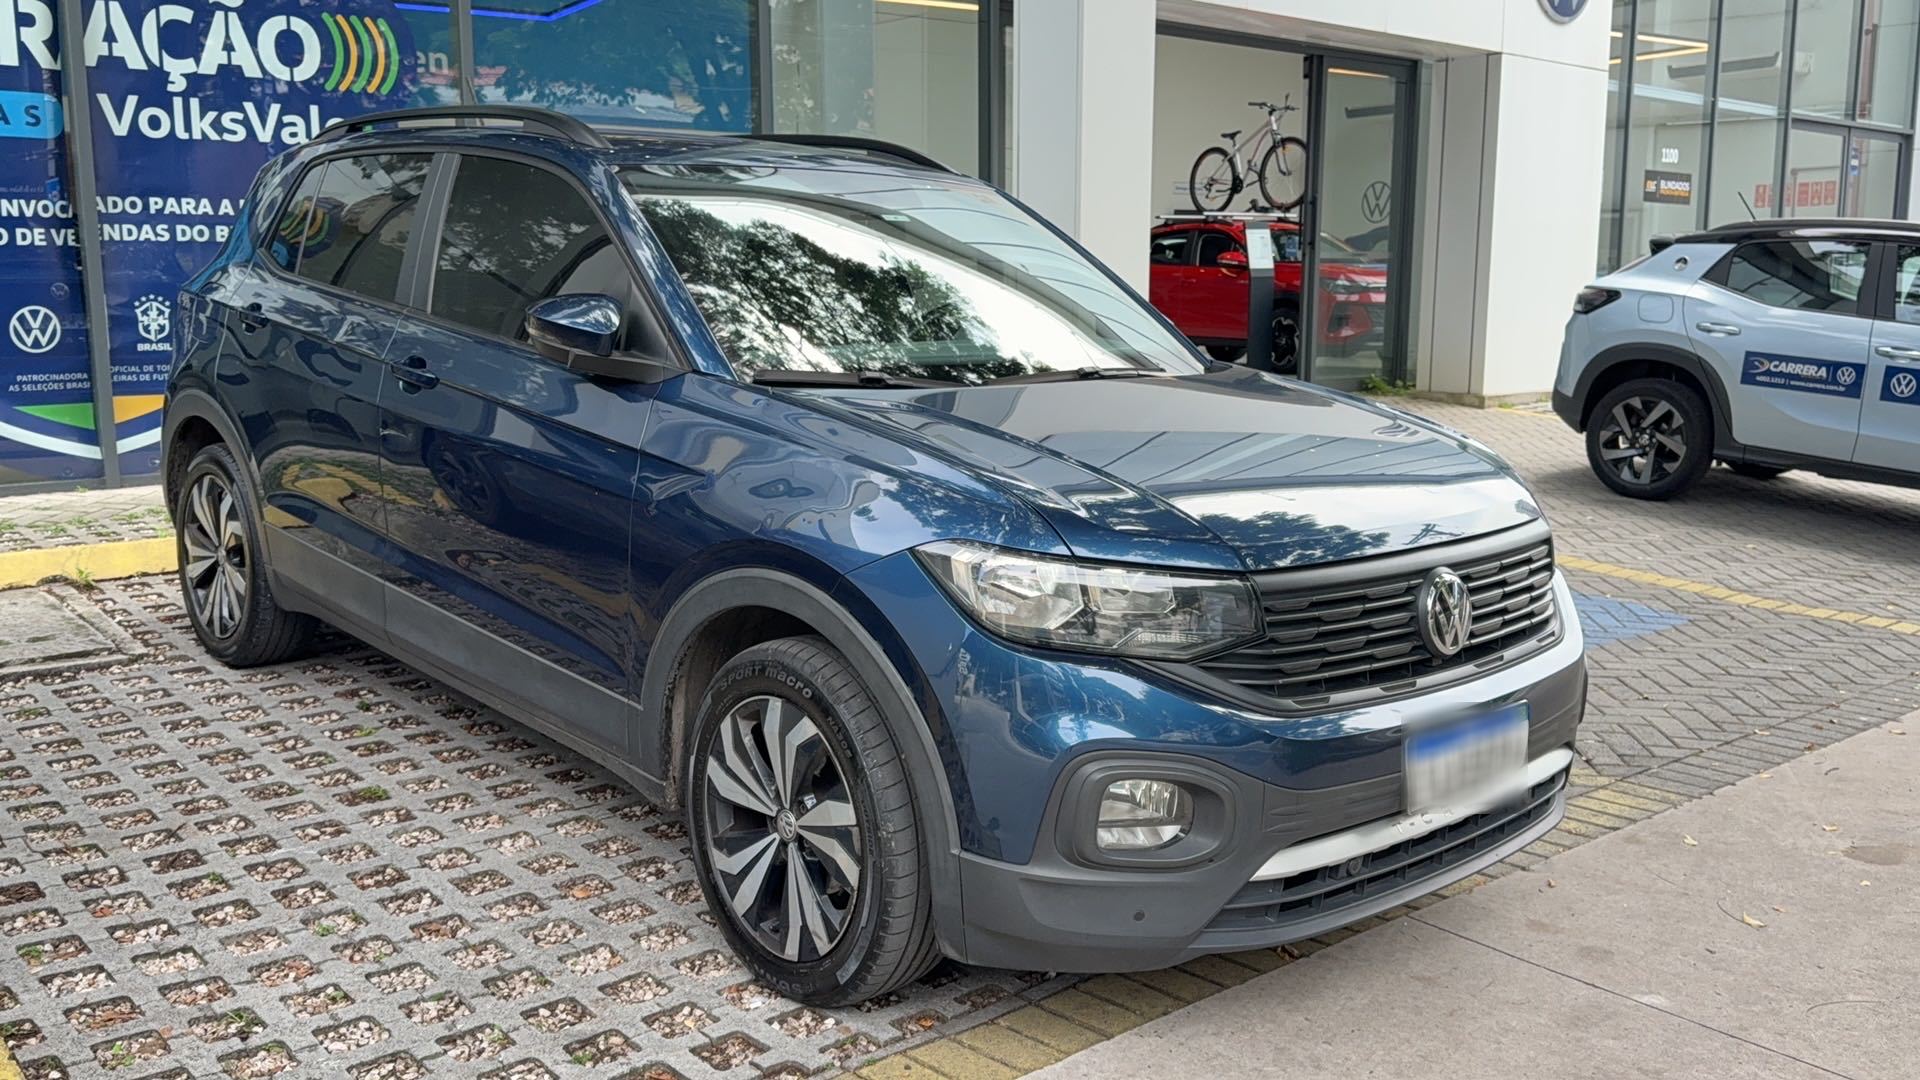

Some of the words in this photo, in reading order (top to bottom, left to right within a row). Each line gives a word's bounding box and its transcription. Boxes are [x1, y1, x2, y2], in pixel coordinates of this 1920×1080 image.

[149, 197, 214, 215] PARA
[218, 199, 235, 215] A
[15, 227, 47, 247] DE
[175, 224, 210, 243] DO
[137, 342, 172, 352] BRASIL
[16, 372, 89, 383] PATROCINADORA
[142, 364, 154, 373] DE
[1769, 360, 1828, 380] CARRERA
[8, 384, 20, 393] AS
[21, 382, 64, 392] SELEÇÕES
[139, 374, 151, 382] DE
[720, 664, 762, 692] SPORT
[765, 666, 813, 699] macro
